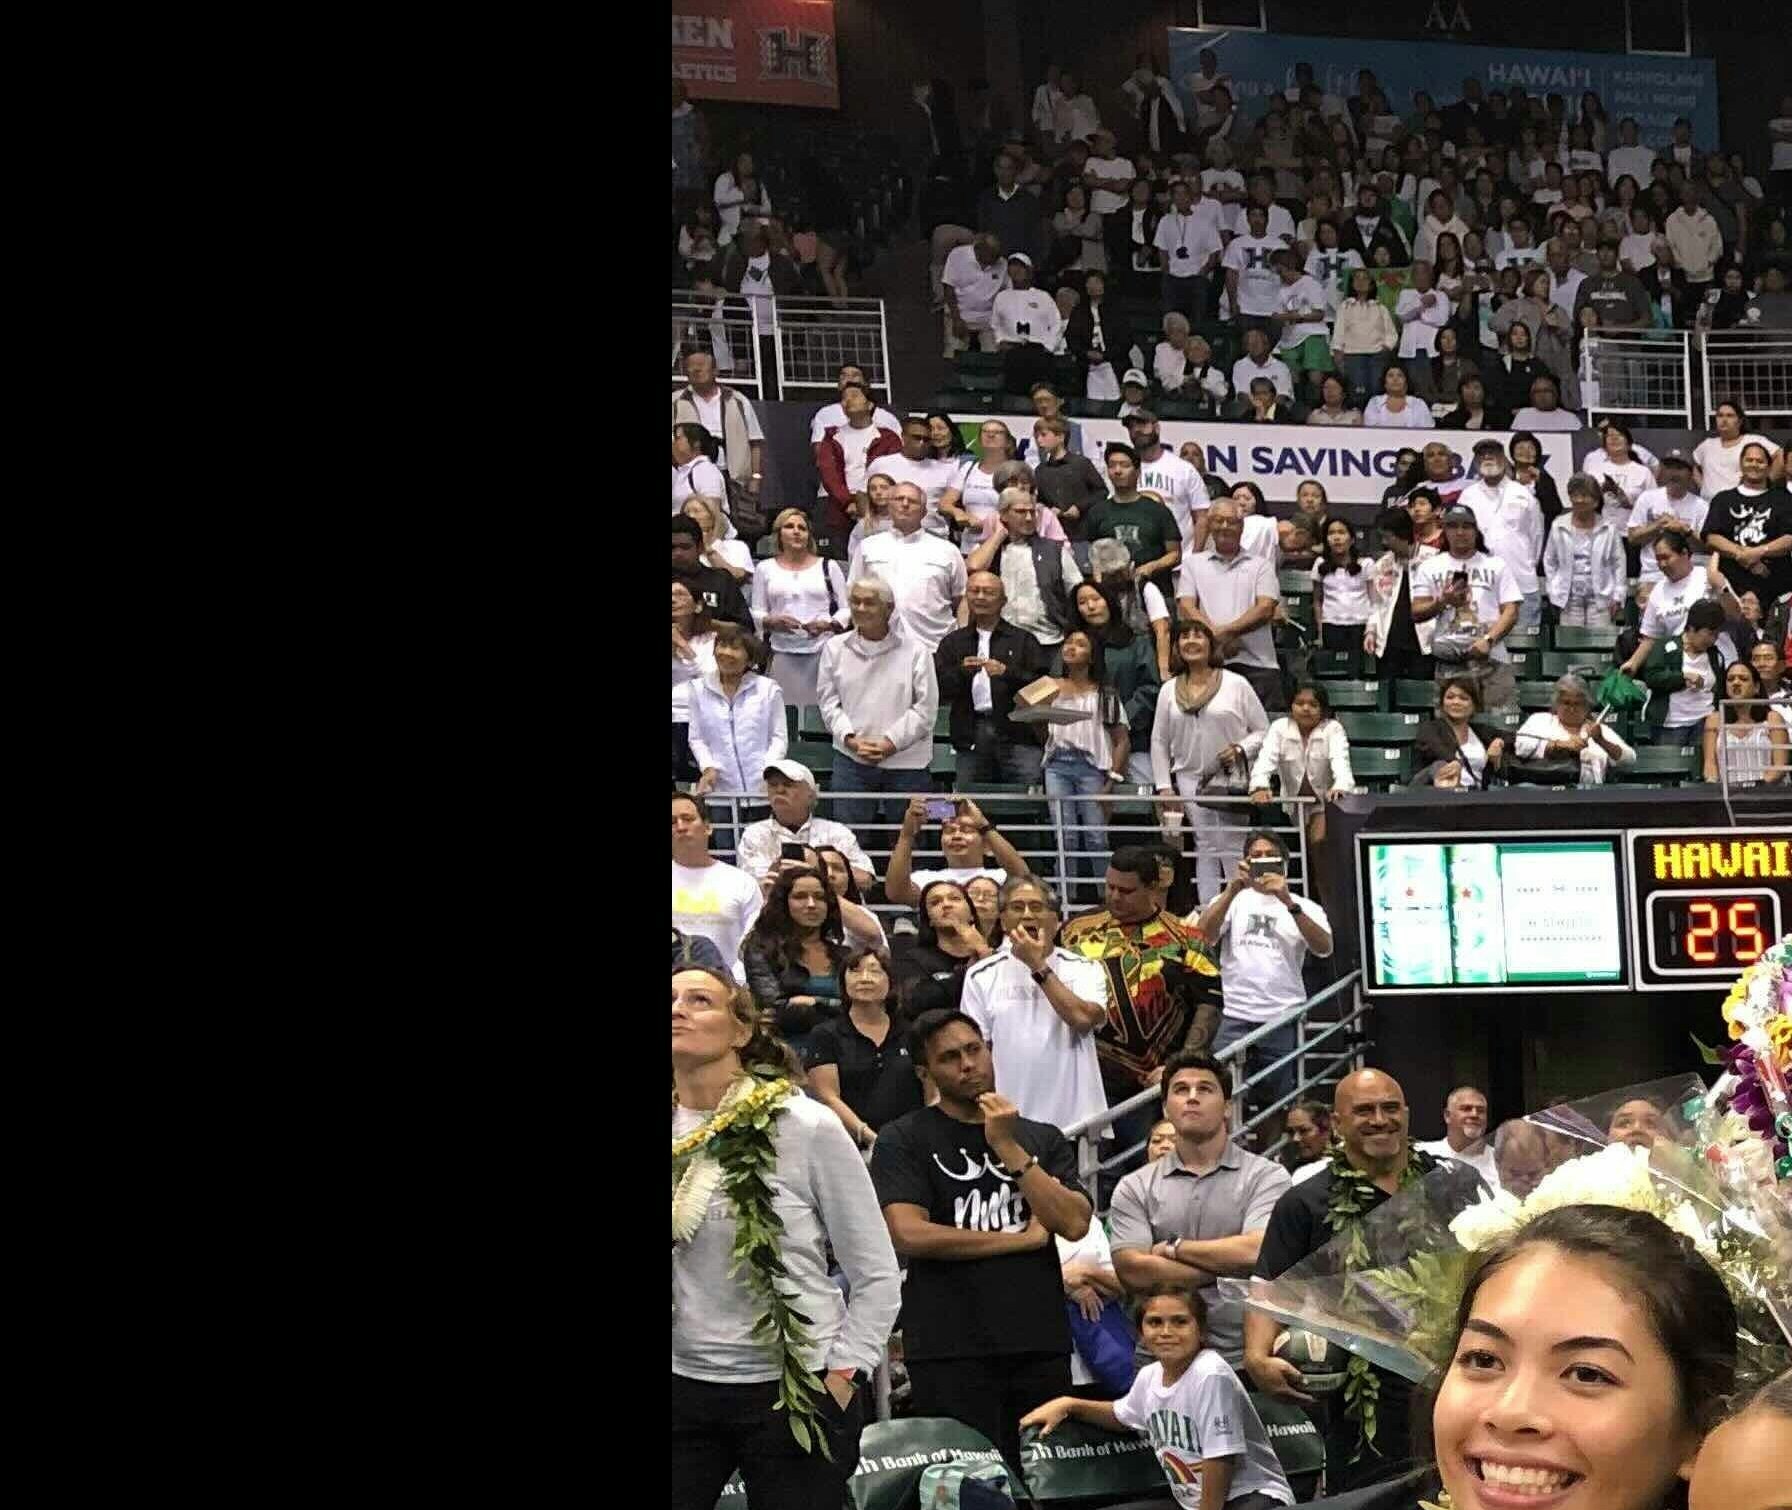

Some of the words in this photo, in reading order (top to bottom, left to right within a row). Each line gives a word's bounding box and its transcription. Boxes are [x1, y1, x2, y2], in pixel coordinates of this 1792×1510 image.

[1687, 902, 1764, 961] 25
[881, 1452, 929, 1471] Bank
[931, 1449, 948, 1463] of
[1055, 1444, 1095, 1460] Bank
[1096, 1442, 1111, 1456] of
